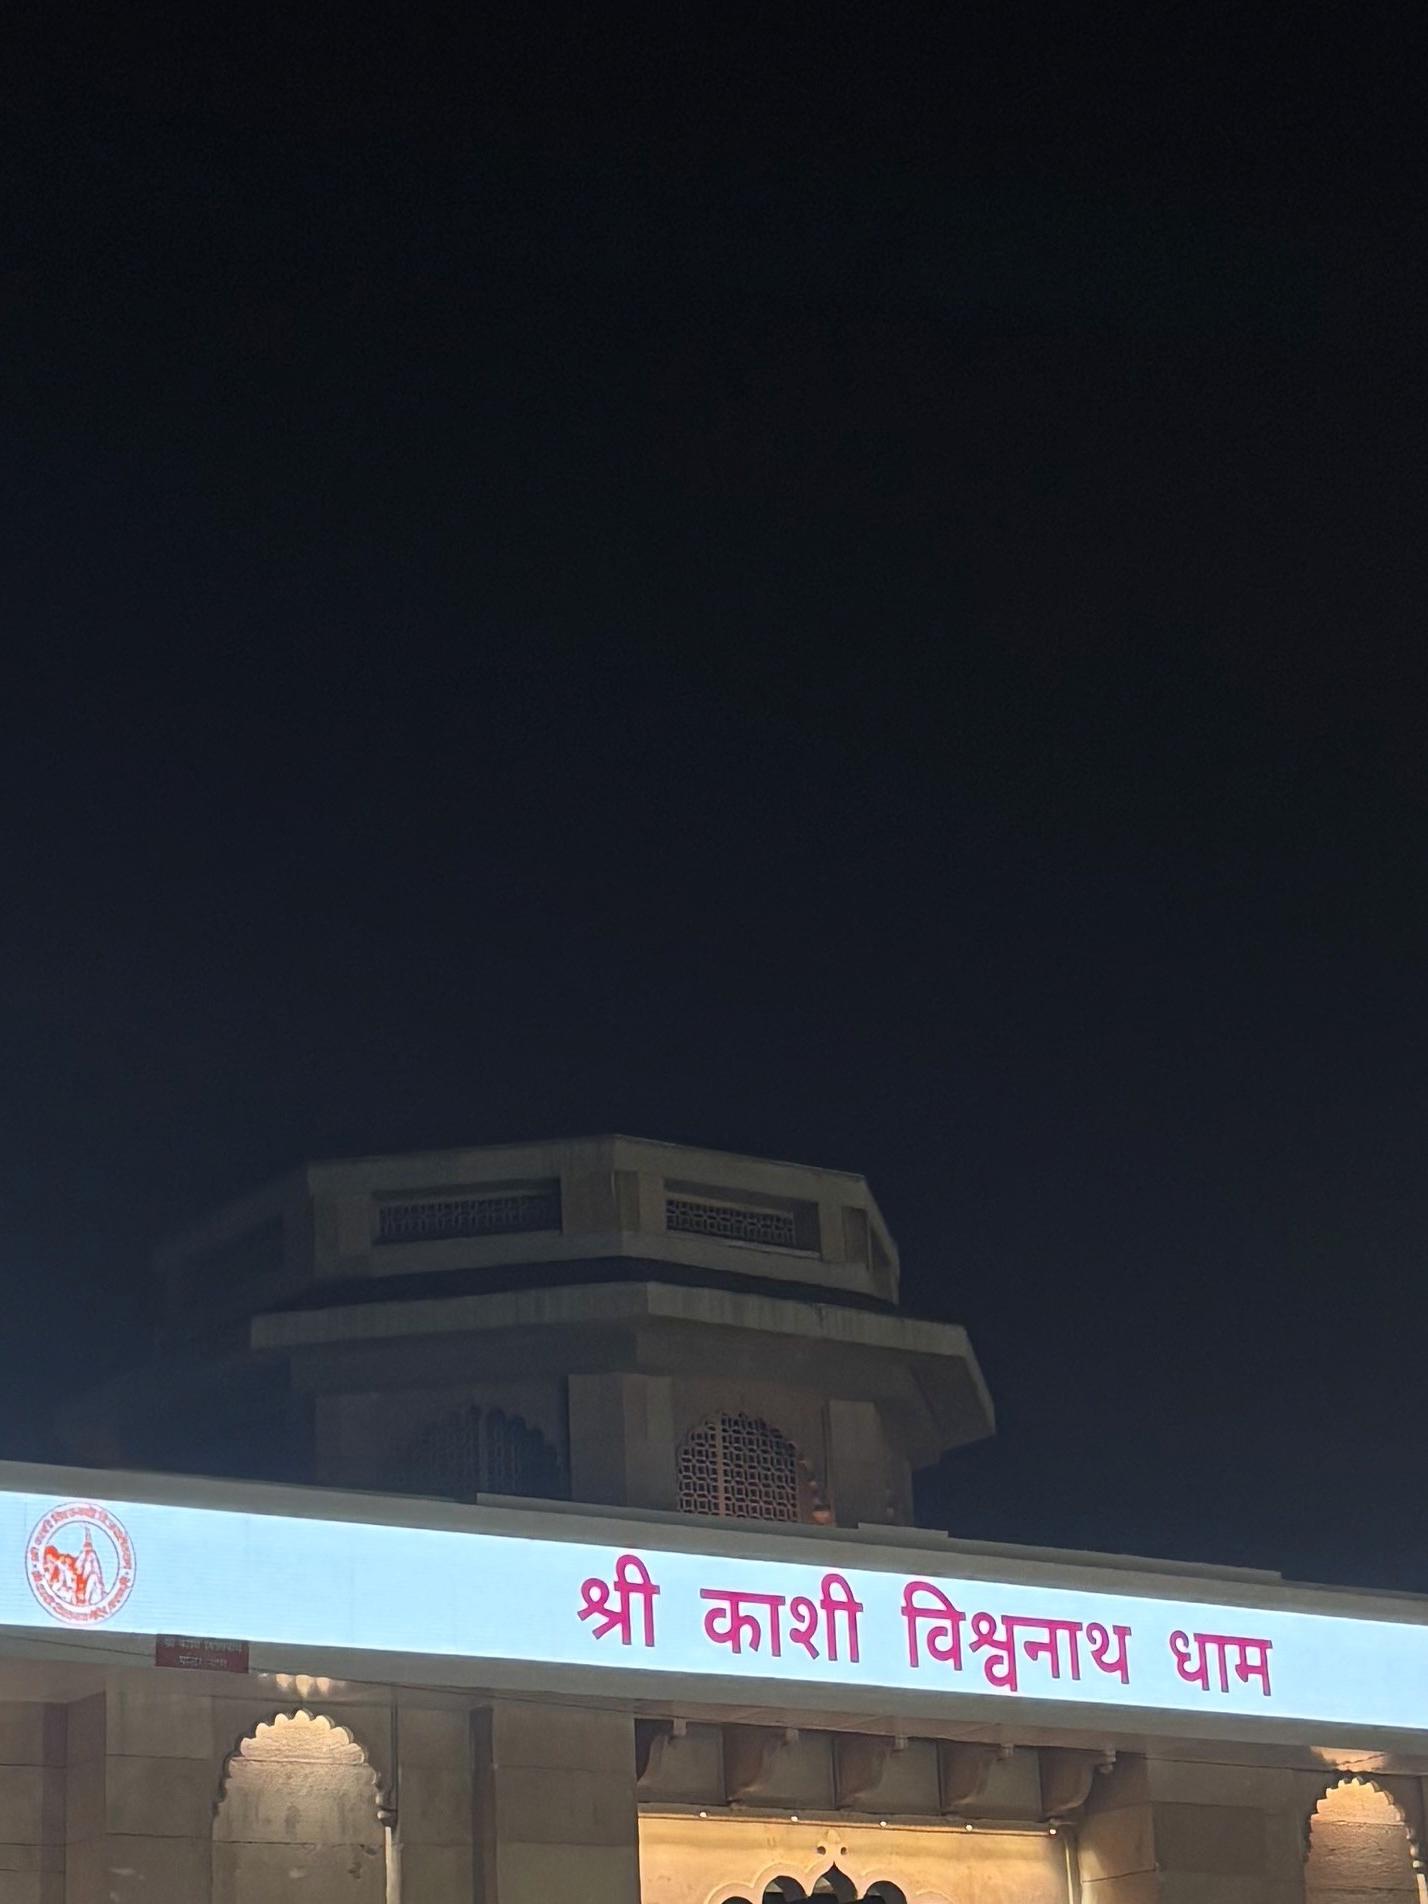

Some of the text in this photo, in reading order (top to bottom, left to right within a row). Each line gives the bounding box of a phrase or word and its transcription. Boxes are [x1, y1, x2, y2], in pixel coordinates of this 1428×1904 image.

[576, 1553, 1274, 1697] श्री काशी विश्वनाथ धाम
